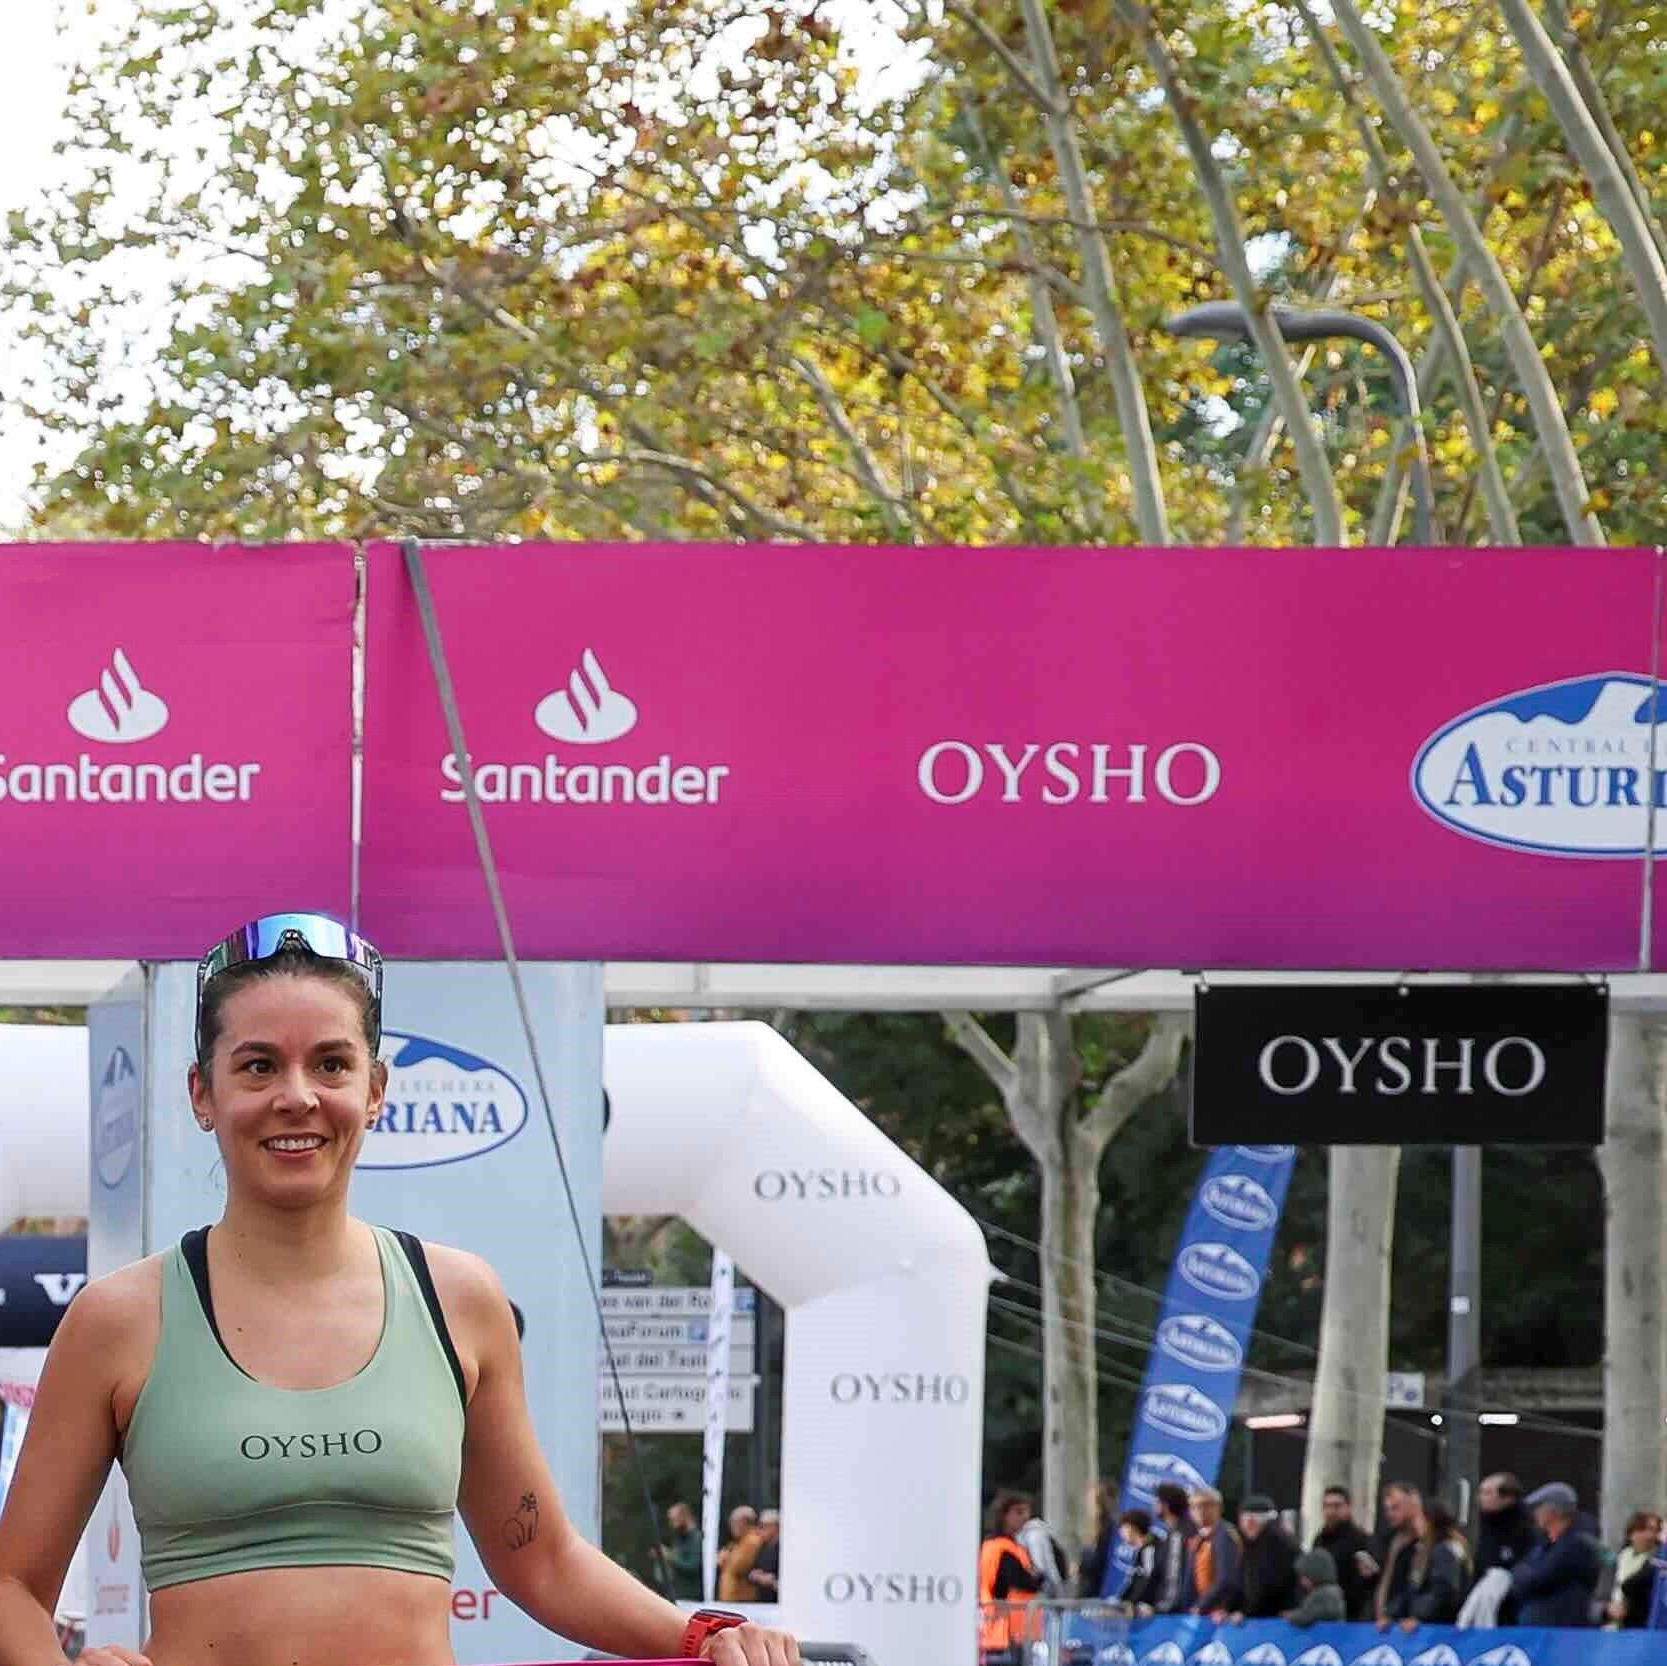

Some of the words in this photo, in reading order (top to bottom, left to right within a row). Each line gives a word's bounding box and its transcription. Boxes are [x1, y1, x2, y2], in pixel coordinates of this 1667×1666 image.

[1506, 737, 1627, 754] CENTRAL
[440, 753, 730, 805] Santander
[918, 741, 1222, 806] OYSHO
[1444, 741, 1667, 809] ASTURI
[1258, 1034, 1546, 1097] OYSHO
[755, 1170, 901, 1201] OYSHO
[830, 1373, 969, 1403] OYSHO
[240, 1429, 382, 1460] OYSHO
[825, 1574, 965, 1604] OYSHO
